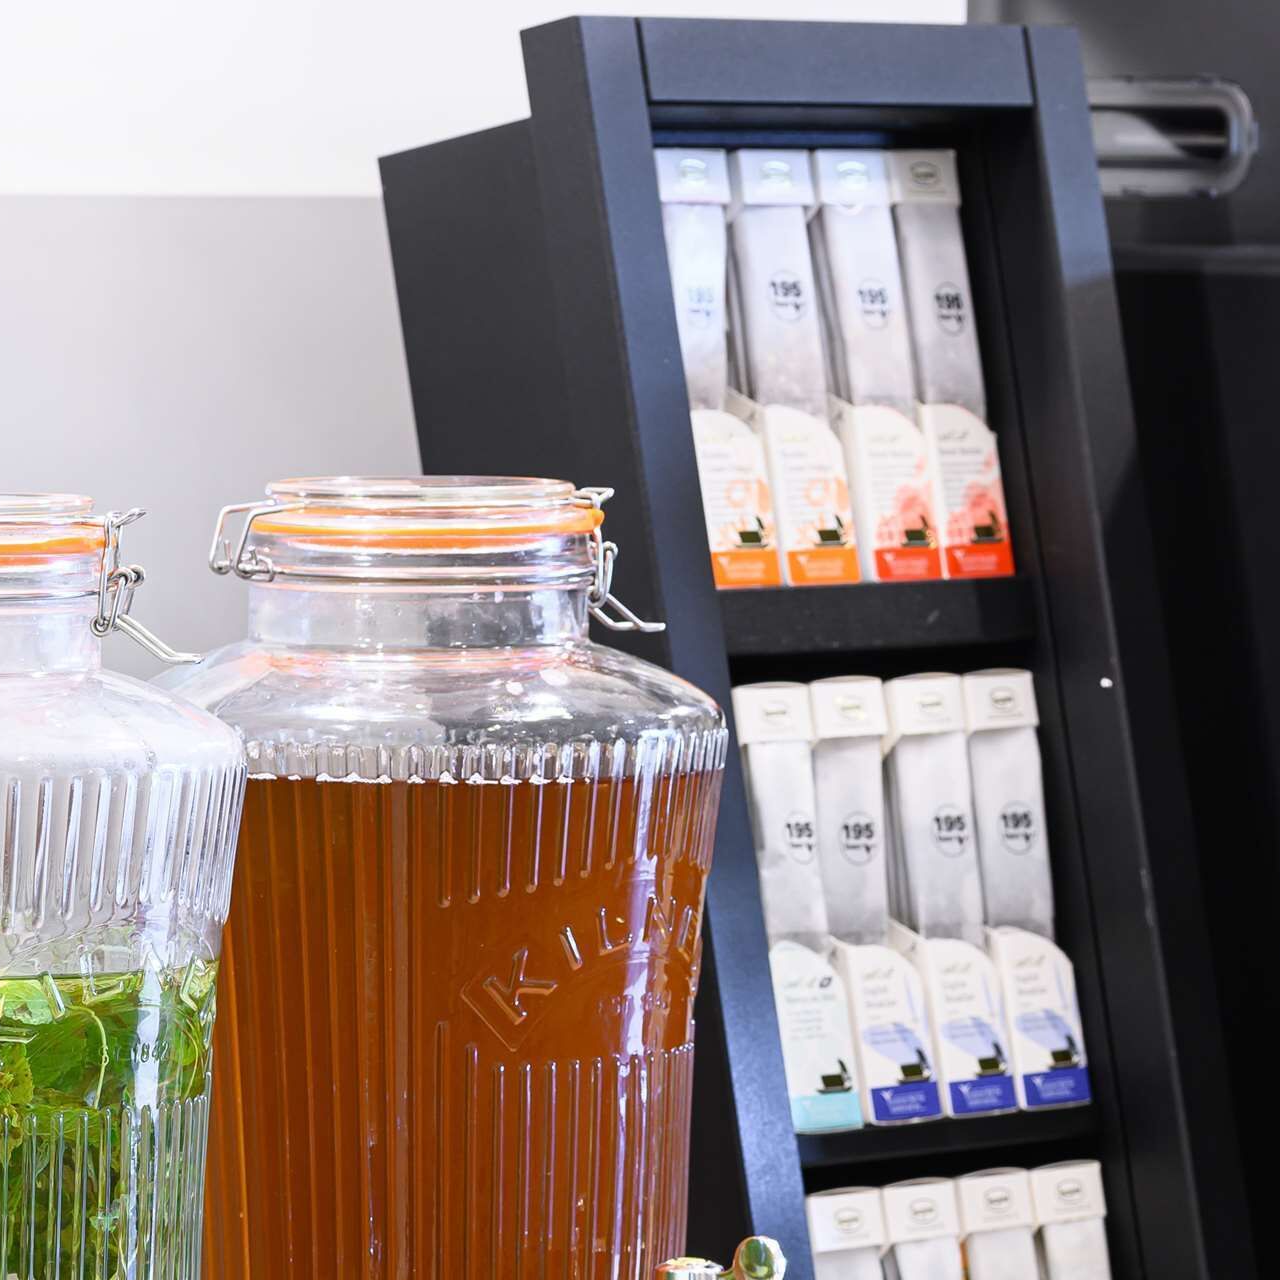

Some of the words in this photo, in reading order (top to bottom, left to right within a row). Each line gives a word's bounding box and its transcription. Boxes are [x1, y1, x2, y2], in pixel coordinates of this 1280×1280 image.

[770, 279, 802, 298] 195
[785, 821, 814, 839] 195
[932, 814, 967, 833] 195
[1000, 811, 1033, 830] 195
[841, 821, 876, 841] 195
